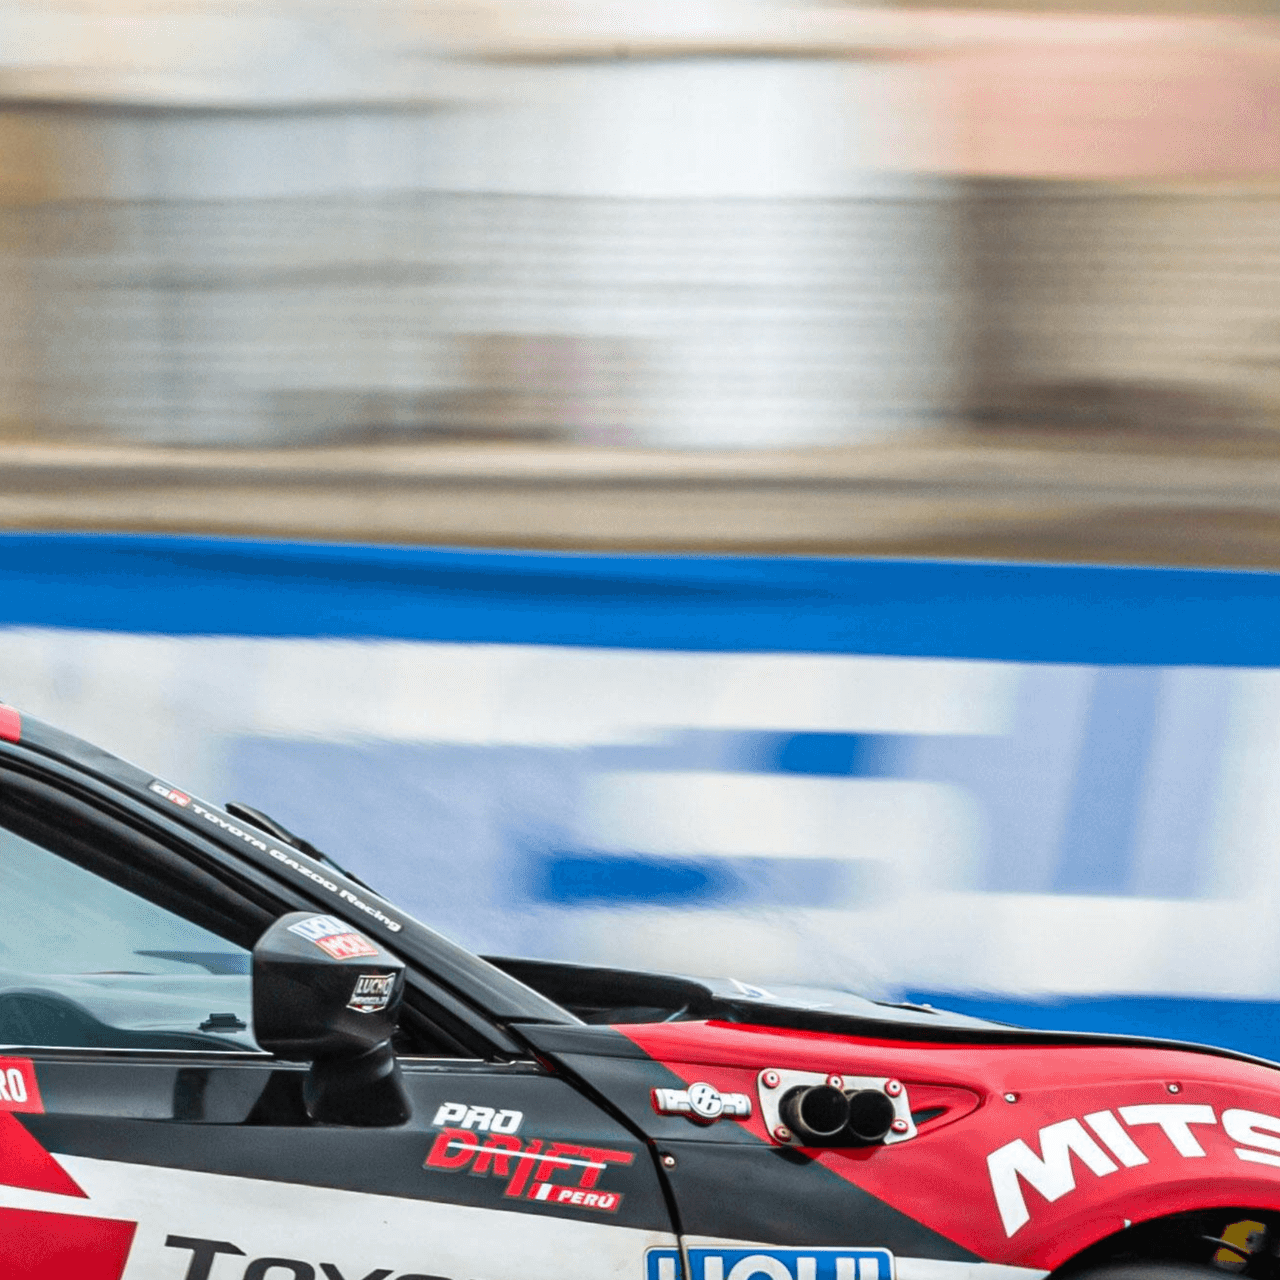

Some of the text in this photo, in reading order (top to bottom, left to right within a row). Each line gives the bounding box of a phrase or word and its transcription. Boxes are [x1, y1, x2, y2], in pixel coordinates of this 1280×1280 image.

[192, 803, 268, 851] TOYOTA
[270, 849, 338, 893] GAZOO
[340, 889, 403, 933] Racing
[433, 1102, 523, 1134] PRO
[424, 1127, 636, 1199] DRIFT
[559, 1189, 614, 1209] PERÚ
